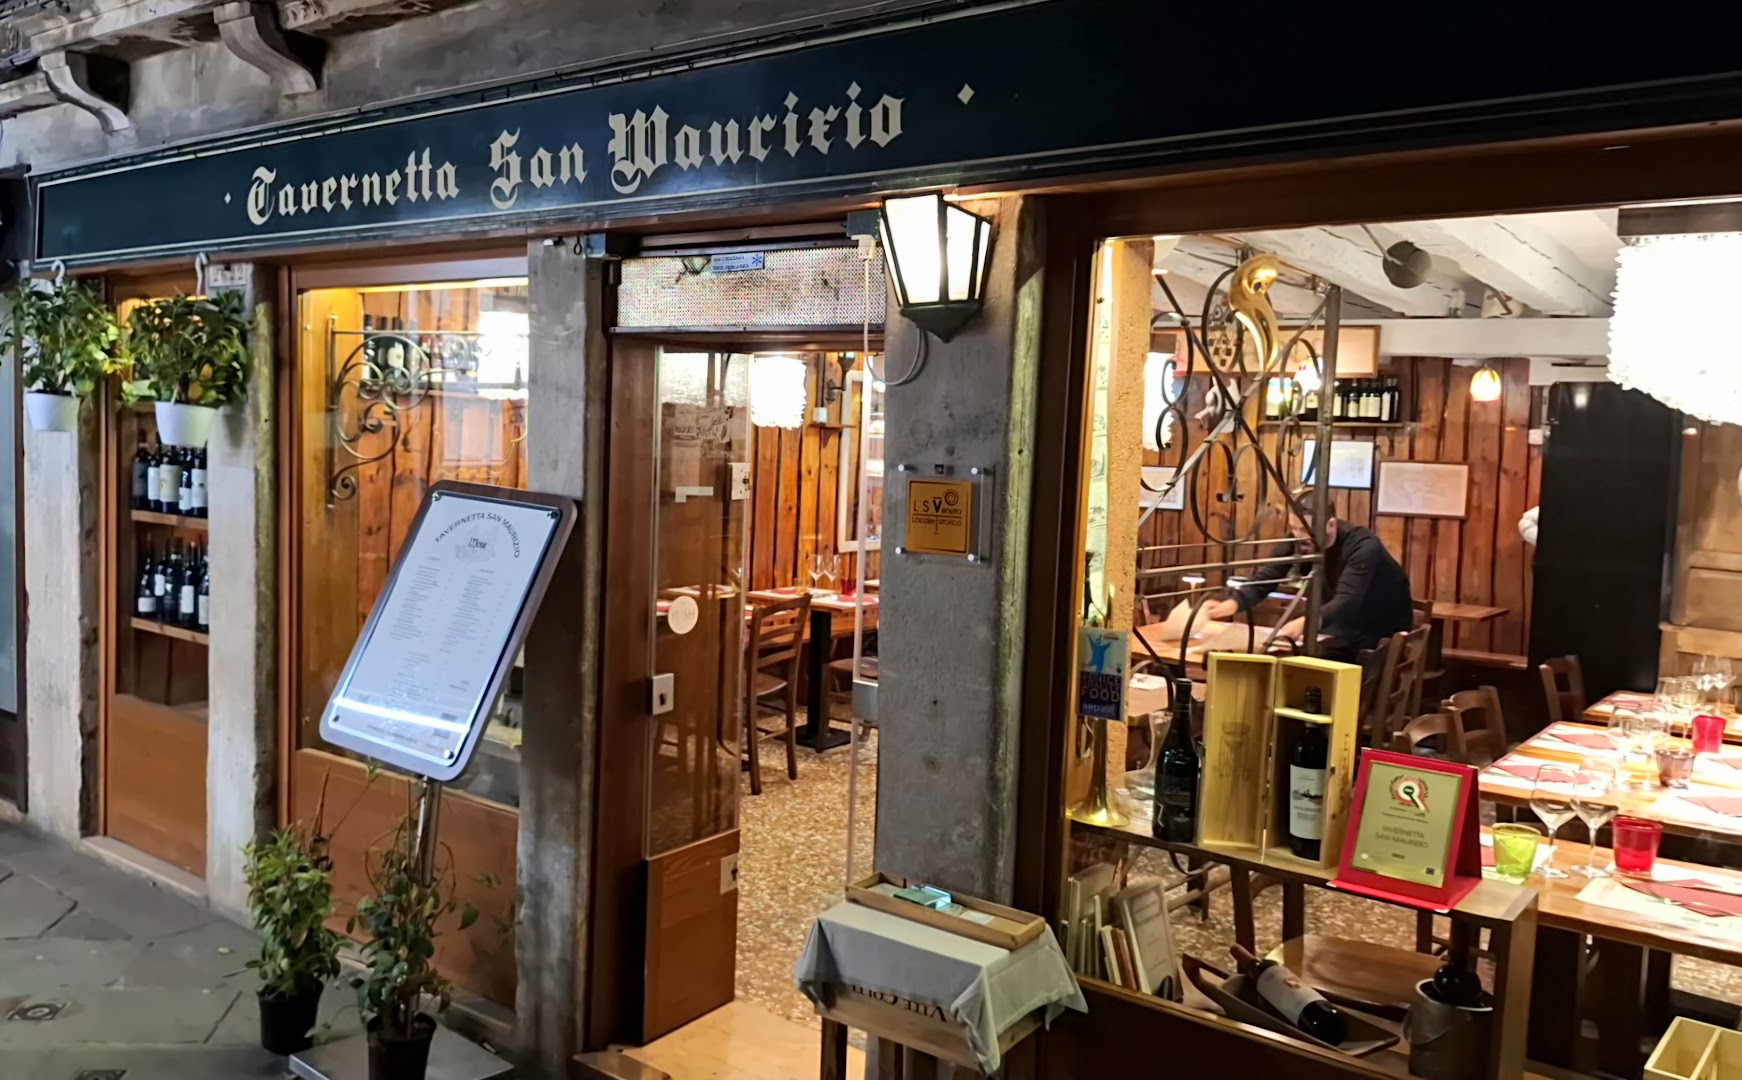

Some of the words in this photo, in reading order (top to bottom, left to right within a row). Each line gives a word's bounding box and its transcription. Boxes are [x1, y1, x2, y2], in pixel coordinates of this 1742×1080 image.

[247, 146, 460, 226] Tavernetta
[488, 127, 589, 209] San
[435, 512, 485, 543] TAVERNETTA
[486, 512, 501, 523] SAN
[502, 518, 521, 558] MAURIZIO
[1081, 688, 1120, 702] FOOD
